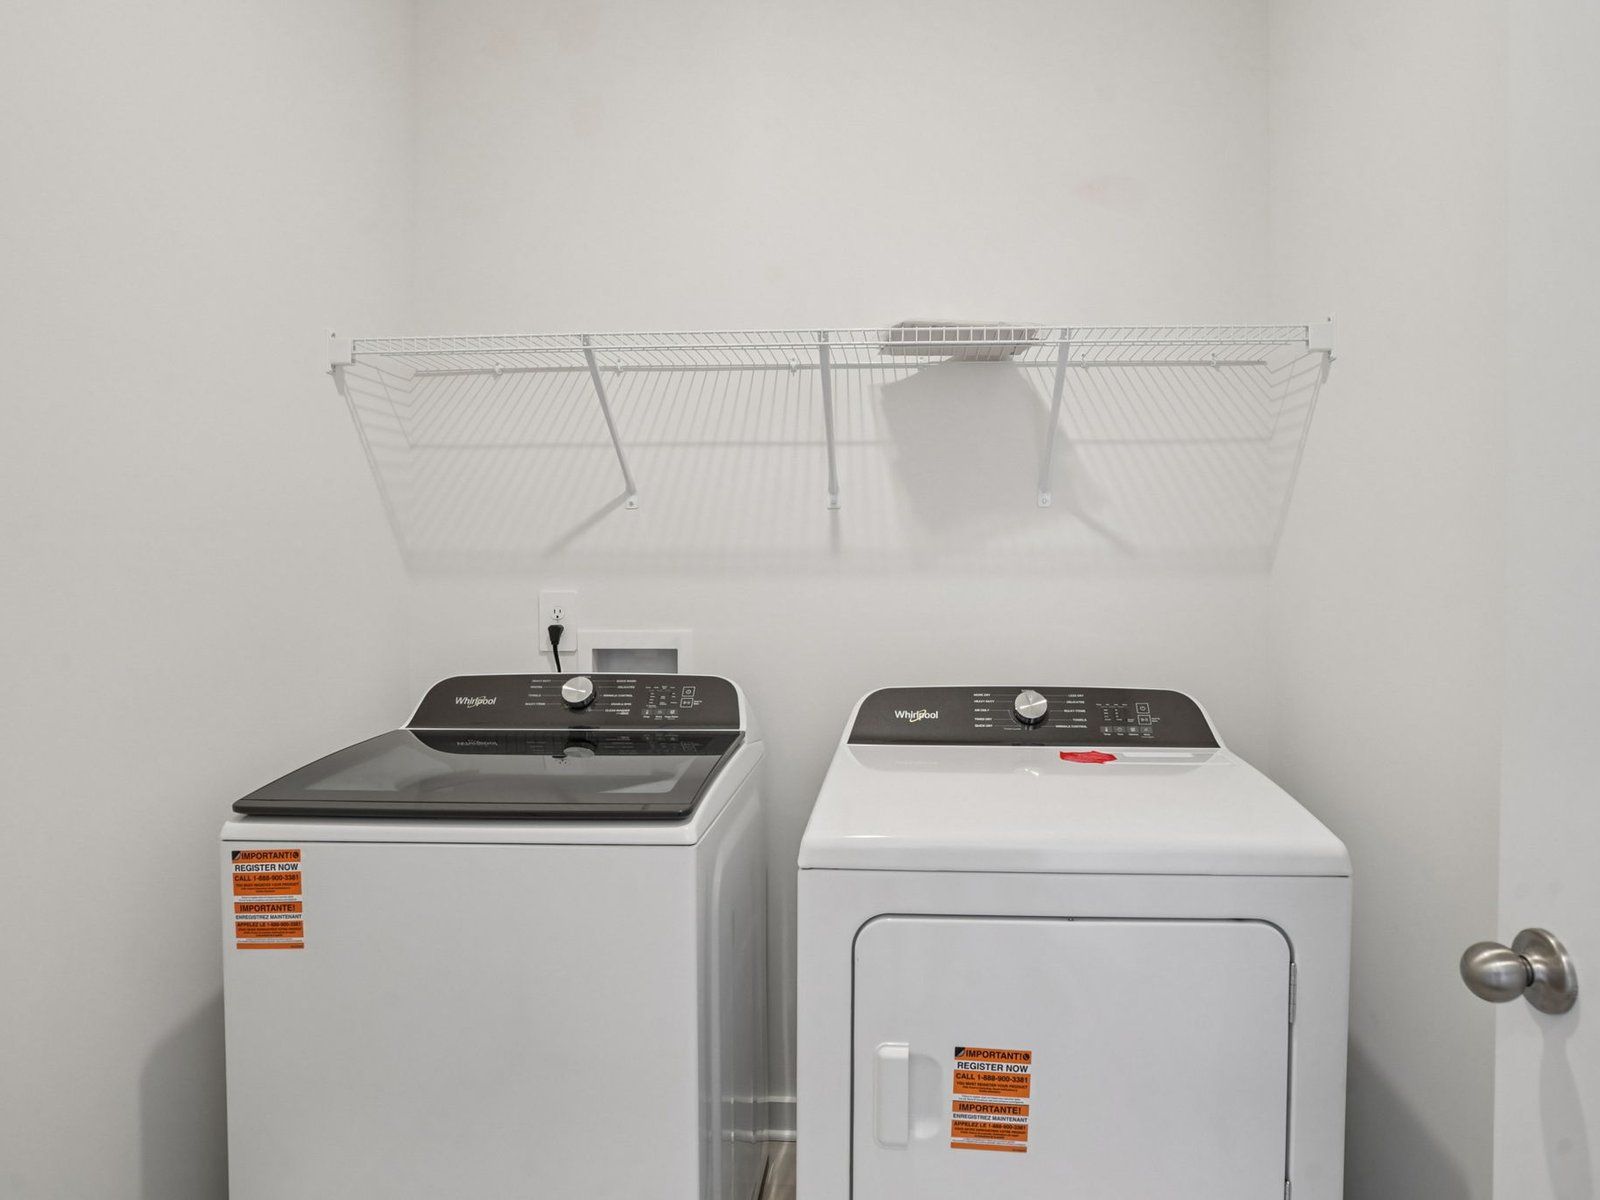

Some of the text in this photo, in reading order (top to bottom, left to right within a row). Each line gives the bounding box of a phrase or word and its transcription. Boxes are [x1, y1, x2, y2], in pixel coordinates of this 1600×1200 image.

[455, 696, 496, 708] Whirlpool
[895, 709, 938, 723] Whirlpool
[241, 851, 292, 860] IMPORTANT!
[235, 863, 298, 872] REGISTER NOW
[240, 904, 295, 912] IMPORTANTE!
[966, 1050, 1022, 1060] IMPORTANT!
[957, 1062, 1028, 1073] REGISTER NOW
[956, 1072, 1027, 1083] CALL 1-888-900-3381
[958, 1103, 1021, 1115] IMPORTANTE!
